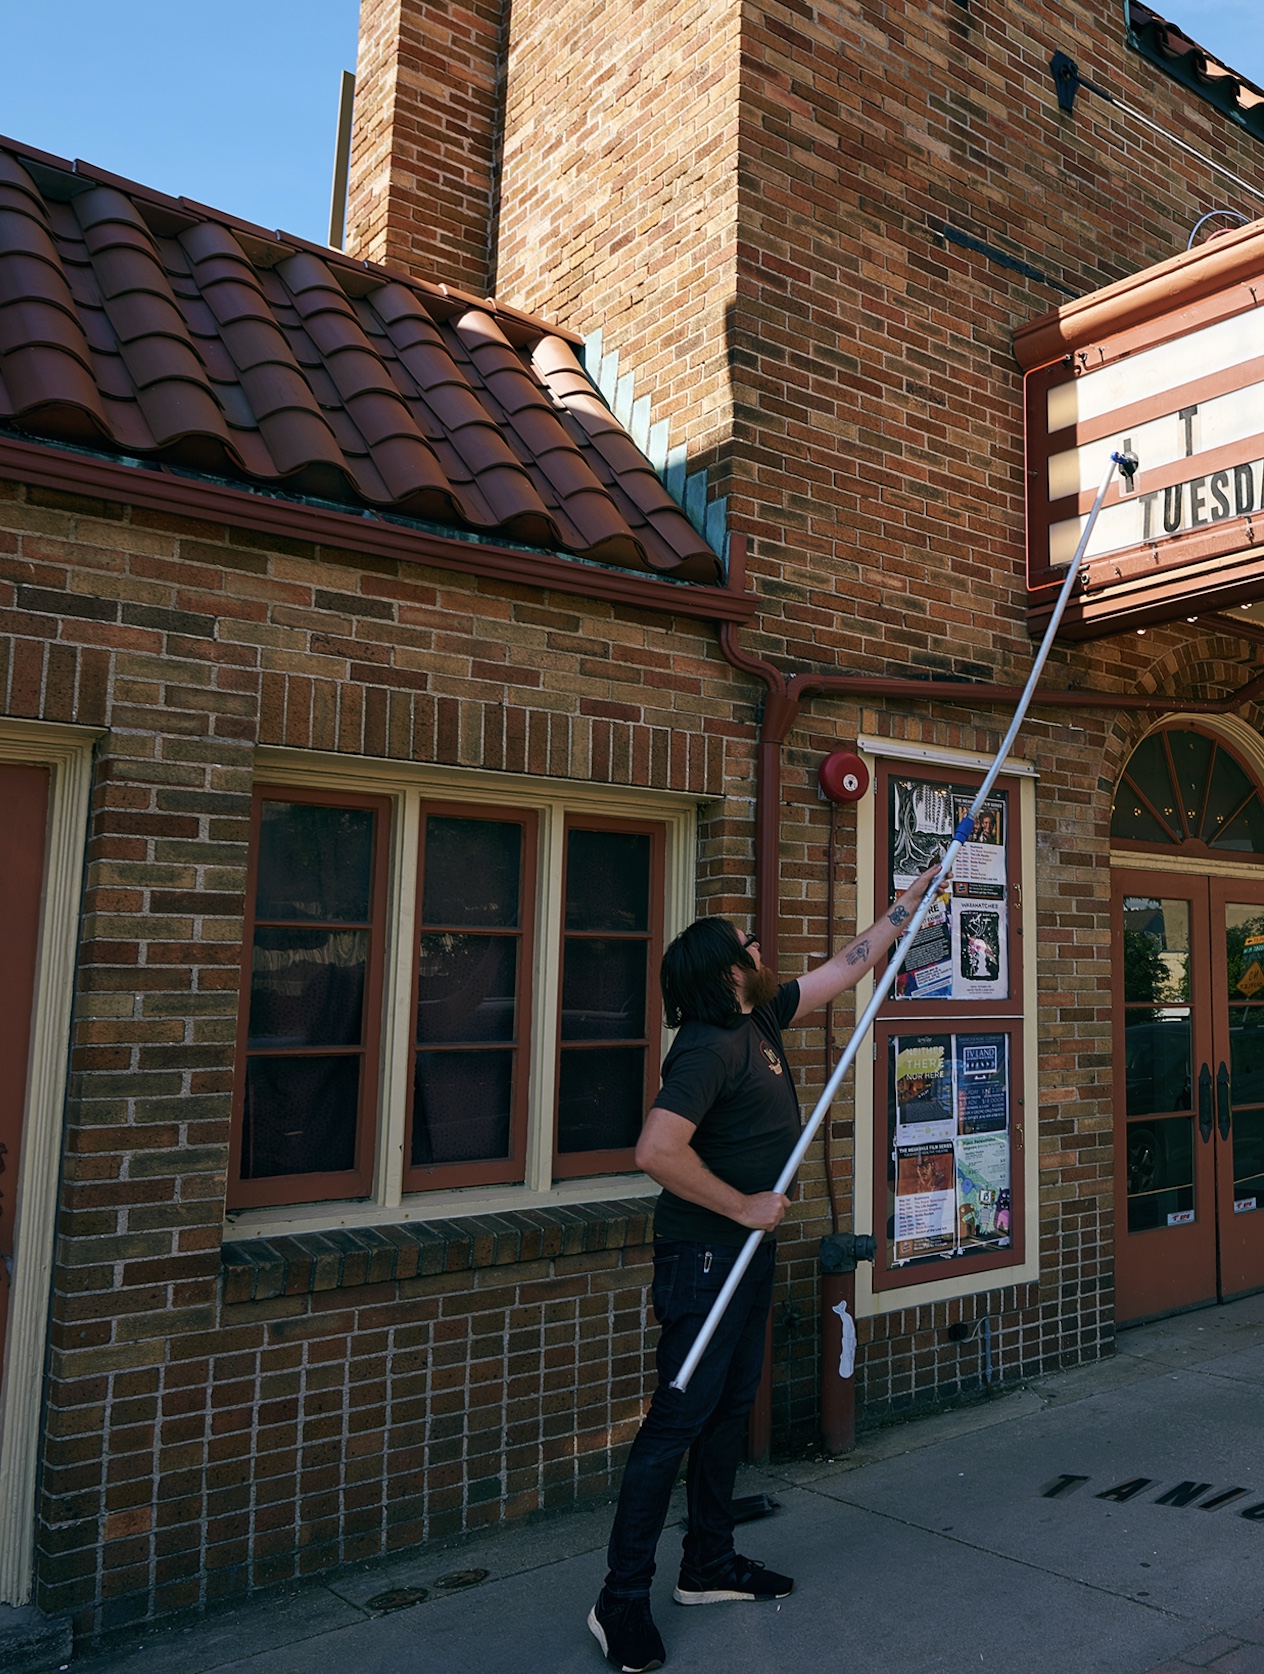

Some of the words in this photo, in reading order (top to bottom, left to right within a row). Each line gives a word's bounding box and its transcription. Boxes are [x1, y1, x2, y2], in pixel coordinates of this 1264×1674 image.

[1178, 404, 1198, 458] T
[906, 1046, 945, 1056] NEITHER
[907, 1058, 945, 1069] THERE
[924, 1071, 945, 1079] HERE
